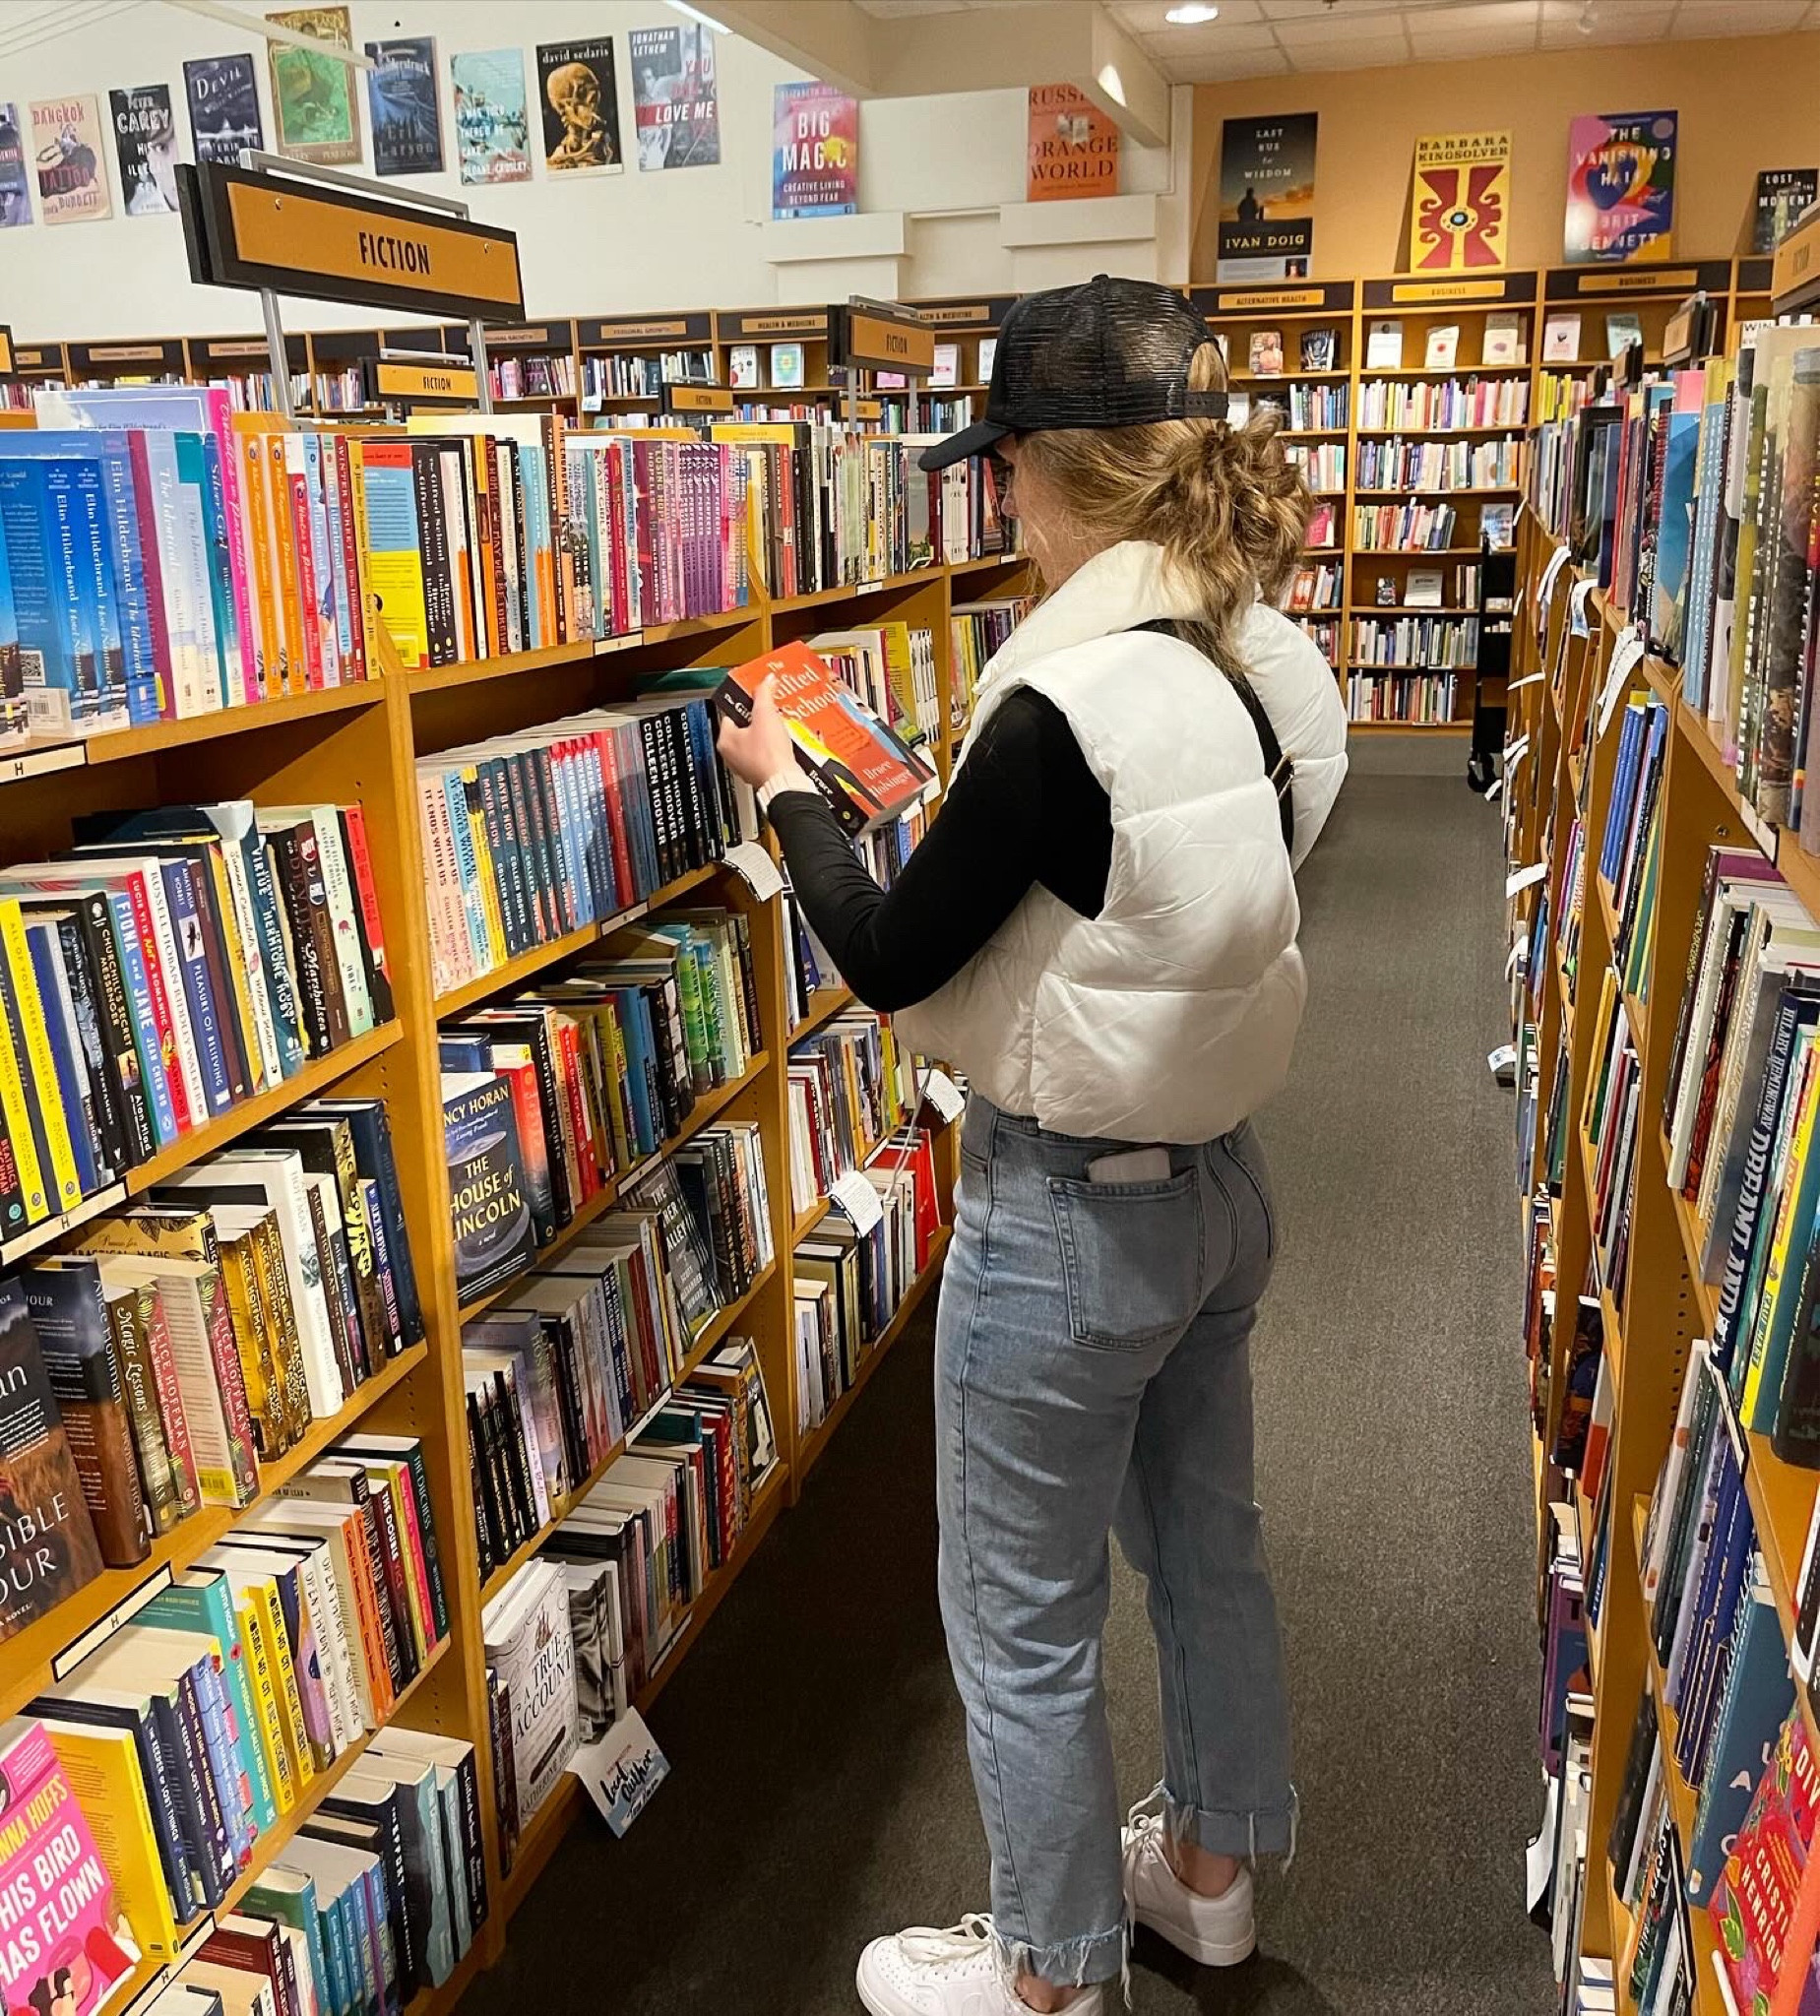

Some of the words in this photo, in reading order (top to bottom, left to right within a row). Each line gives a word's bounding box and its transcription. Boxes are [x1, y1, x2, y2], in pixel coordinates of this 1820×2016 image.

[542, 50, 570, 64] david
[574, 47, 610, 61] sedaris
[631, 33, 676, 45] JONATHAN
[197, 66, 244, 99] DEVIL
[32, 104, 86, 126] BANGKOK
[116, 111, 171, 135] CAREY
[655, 104, 689, 123] LOVE
[693, 101, 715, 119] ME
[798, 110, 830, 140] BIG
[1255, 128, 1285, 139] LAST
[1608, 127, 1641, 142] THE
[782, 141, 847, 172] MAGC
[1418, 135, 1509, 152] BARBARA
[1418, 146, 1509, 162] KINGSOLVER
[1577, 147, 1671, 166] VANISHING
[783, 180, 818, 193] CREATIVE
[819, 179, 846, 191] LIVING
[1032, 159, 1113, 180] WORLD
[1244, 167, 1292, 179] WISDOM
[1766, 173, 1792, 185] LOST
[788, 193, 818, 206] BEYOND
[1759, 194, 1813, 208] MOMENT
[359, 231, 430, 275] FICTION
[1225, 235, 1262, 250] IVAN
[1267, 233, 1305, 247] DOIG
[1236, 296, 1280, 305] ALTERNATIVE
[1282, 294, 1306, 303] HEALTH
[886, 332, 909, 354] FICTION
[422, 375, 451, 391] FICTION
[110, 461, 122, 493] Elin
[418, 475, 429, 518] Gifted
[429, 473, 441, 514] Gifted
[56, 494, 67, 522] Elin
[86, 493, 95, 520] Elin
[61, 526, 78, 601] Hilderbrand
[89, 524, 105, 598] Hilderbrand
[115, 499, 135, 593] Hilderbrand
[1798, 569, 1813, 641] PETER
[1743, 595, 1757, 675] PETER
[774, 663, 822, 700] Gifted
[784, 686, 838, 721] School
[1790, 654, 1807, 738] HELLER
[1736, 685, 1750, 780] HELLER
[15, 763, 24, 776] H
[566, 756, 578, 810] NOVEMBER
[644, 723, 659, 786] COLLEEN
[653, 788, 666, 846] HOOVER
[655, 720, 669, 782] COLLEEN
[664, 785, 677, 841] HOOVER
[664, 716, 677, 776] COLLEEN
[673, 780, 686, 835] HOOVER
[680, 712, 694, 773] COLLEEN
[689, 776, 701, 830] HOOVER
[862, 761, 893, 781] Bruce
[868, 768, 913, 798] Holsinger
[426, 804, 437, 833] ENDS
[439, 803, 451, 835] ENDS
[482, 779, 493, 818] MAYBE
[489, 821, 500, 849] NOW
[496, 772, 507, 811] MAYBE
[503, 814, 514, 841] NOW
[151, 870, 168, 931] RUSSELL
[181, 867, 195, 910] ANASTASIA
[497, 862, 507, 898] COLLEEN
[503, 900, 513, 932] HOOVER
[510, 855, 520, 891] COLLEEN
[516, 893, 526, 924] HOOVER
[525, 854, 534, 892] COLLEEN
[531, 894, 540, 926] HOOVER
[251, 846, 269, 896] VIRTUE
[261, 909, 284, 980] HERMIONE
[115, 902, 138, 954] FIONA
[132, 987, 154, 1030] JANE
[132, 880, 145, 909] LUCIE
[151, 972, 168, 1027] ROMANTIC
[100, 928, 123, 1005] CHURCHILL'S
[118, 1008, 133, 1046] SECRET
[100, 957, 120, 1027] MESSENGER
[305, 941, 327, 1032] Marshalsea
[192, 964, 209, 1013] PLEASURE
[206, 1035, 223, 1087] BELIEVING
[1775, 1006, 1796, 1054] HILARY
[145, 1037, 157, 1061] JEAN
[134, 1095, 146, 1117] Alan
[470, 1085, 510, 1115] HORAN
[1761, 1055, 1786, 1130] HEMINGWAY
[450, 1171, 501, 1217] HOUSE
[504, 1163, 515, 1189] of
[465, 1155, 490, 1180] THE
[60, 1217, 70, 1229] H
[313, 1189, 324, 1230] ALICE
[320, 1234, 337, 1295] HOFFMAN
[347, 1186, 373, 1272] HOFFMAN
[483, 1230, 497, 1245] novel
[1719, 1128, 1772, 1314] DREAMLAND
[247, 1286, 265, 1343] HOFFMAN
[264, 1273, 282, 1328] HOFFMAN
[1758, 1292, 1774, 1326] KAUI
[93, 1279, 112, 1323] Alice
[103, 1332, 123, 1405] Hoffman
[116, 1307, 139, 1357] Magic
[1752, 1332, 1765, 1368] HART
[126, 1362, 149, 1413] Lessons
[155, 1322, 173, 1371] ALICE
[164, 1373, 188, 1450] HOFFMAN
[215, 1307, 232, 1354] ALICE
[225, 1358, 247, 1431] HOFFMAN
[385, 1515, 399, 1561] DOUBLE
[110, 1614, 120, 1629] H
[305, 1572, 320, 1606] OPEN
[313, 1611, 330, 1657] THROAT
[322, 1557, 337, 1590] OPEN
[330, 1597, 345, 1644] THROAT
[533, 1631, 562, 1687] TRUE
[514, 1646, 573, 1745] ACCOUNT
[524, 1686, 532, 1703] A
[151, 1740, 163, 1773] KEEPER
[160, 1786, 171, 1807] LOST
[167, 1810, 179, 1841] THINGS
[189, 1770, 199, 1794] LOST
[196, 1796, 206, 1825] THINGS
[464, 1779, 473, 1809] Gifted
[620, 1747, 654, 1803] author
[26, 1773, 69, 1824] HOFFS
[468, 1811, 476, 1848] School
[32, 1823, 81, 1892] BIRD
[392, 1824, 405, 1886] EFFORT
[36, 1855, 104, 1945] FLOWN
[1756, 1848, 1790, 1934] CRISTI
[160, 1971, 170, 1984] H
